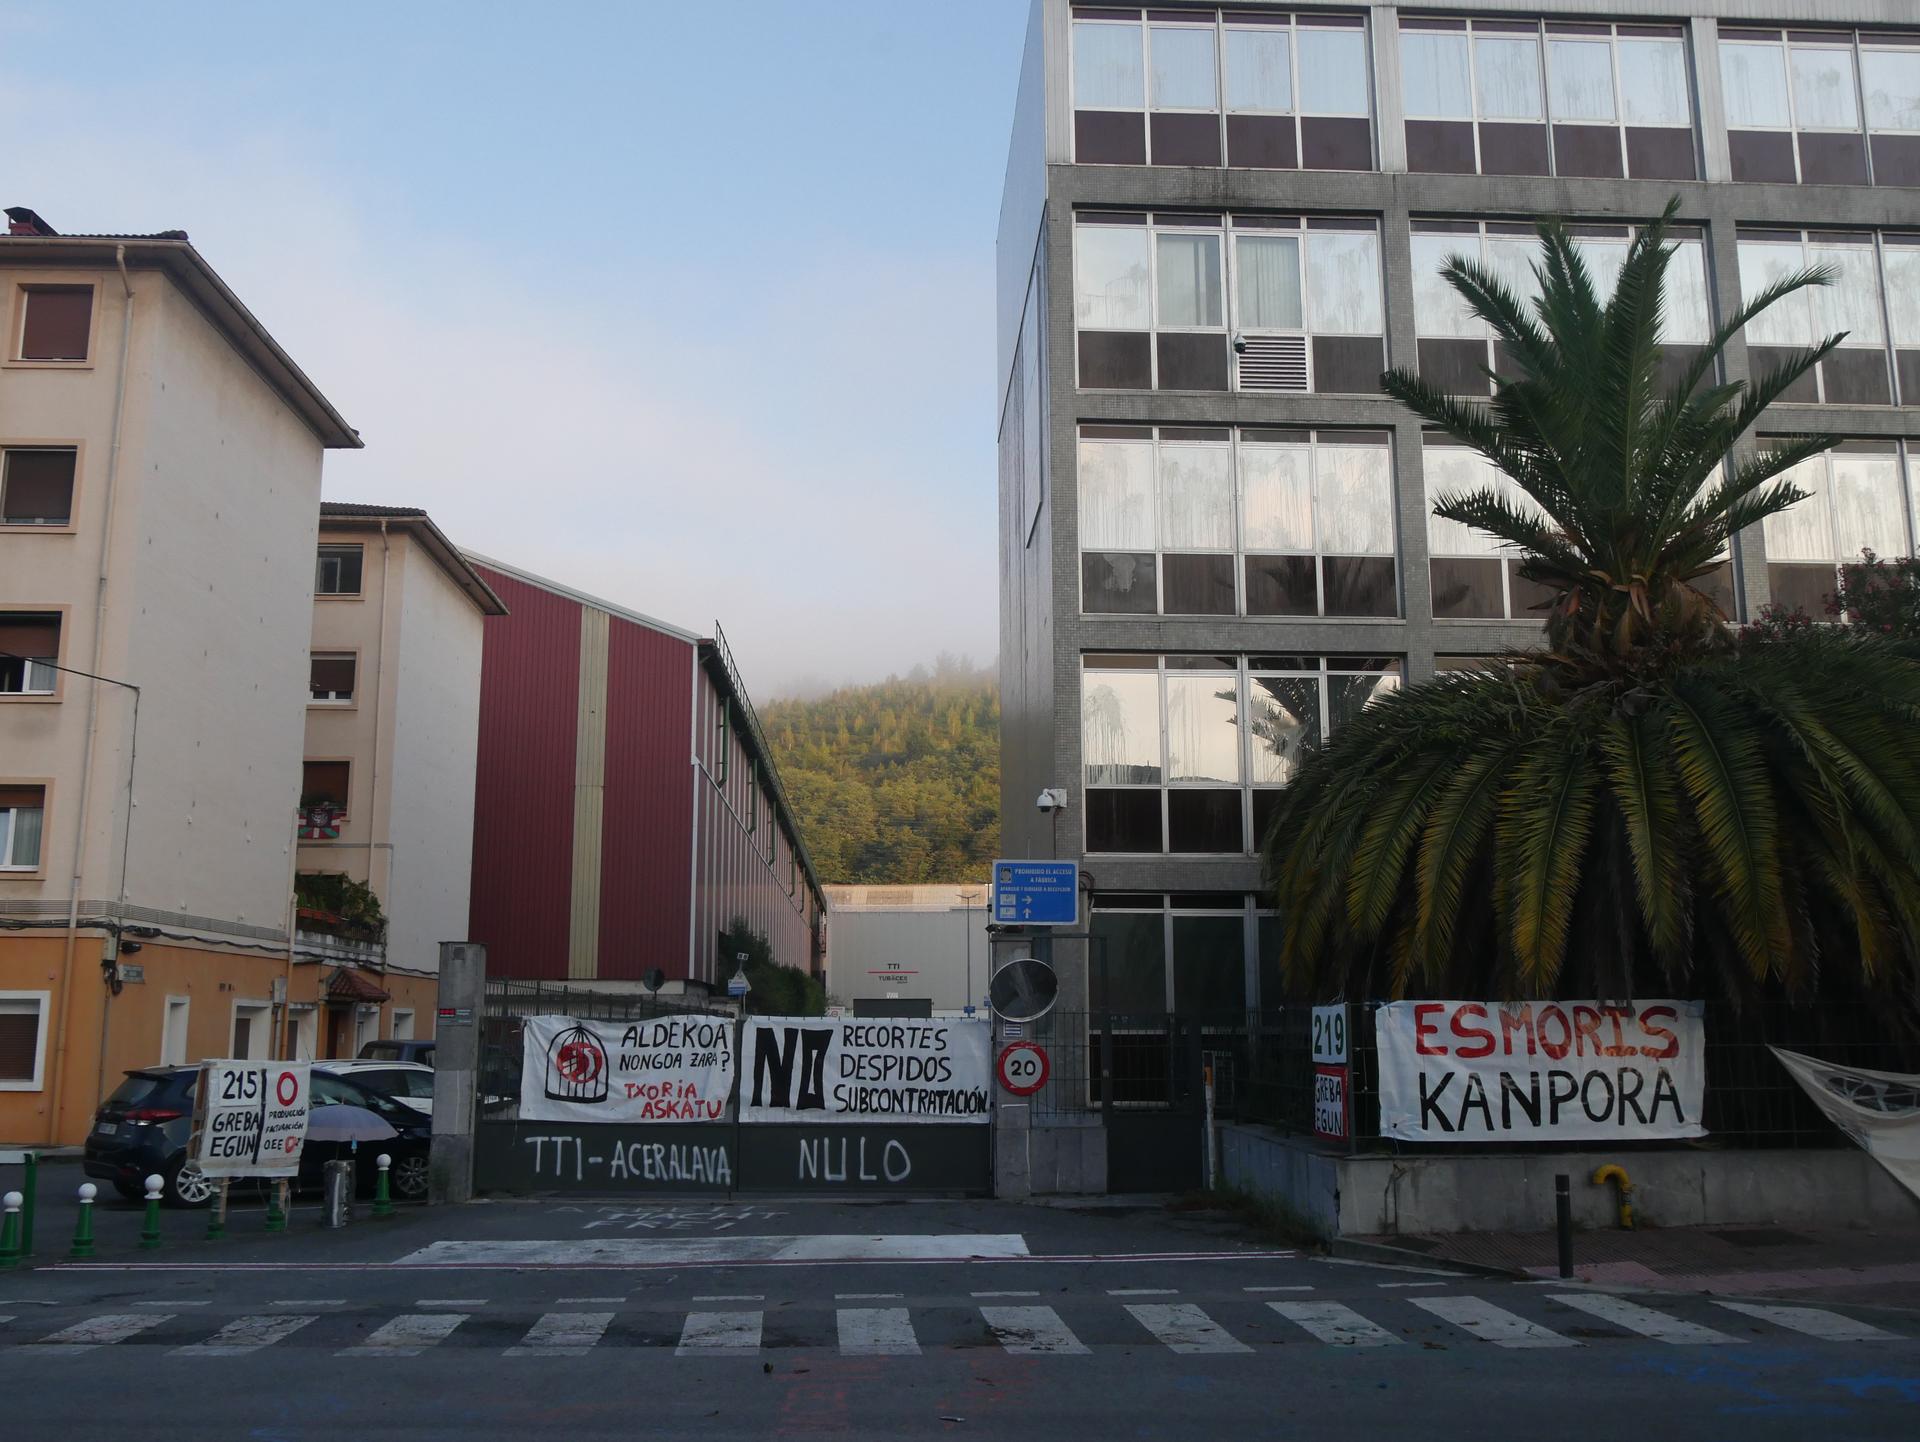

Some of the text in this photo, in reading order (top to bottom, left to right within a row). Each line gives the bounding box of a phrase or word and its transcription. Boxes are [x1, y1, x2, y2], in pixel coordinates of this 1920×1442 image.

[620, 1022, 728, 1050] ALDEKOA
[842, 1025, 949, 1051] RECORTES
[1313, 1013, 1344, 1056] 219
[1413, 1003, 1682, 1061] ESMORIS
[619, 1053, 682, 1072] NONGOA
[750, 1027, 834, 1111] NO
[840, 1053, 953, 1083] DESPIDOS
[1011, 1060, 1036, 1076] 20
[222, 1070, 257, 1099] 215
[640, 1099, 722, 1120] ASKATU
[833, 1084, 988, 1115] SUBCONTRATACIÓN
[1418, 1065, 1686, 1133] KANPORA
[212, 1111, 260, 1134] GREBA
[1316, 1108, 1342, 1135] EGUN
[210, 1134, 256, 1158] EGUN
[798, 1136, 911, 1182] NULO
